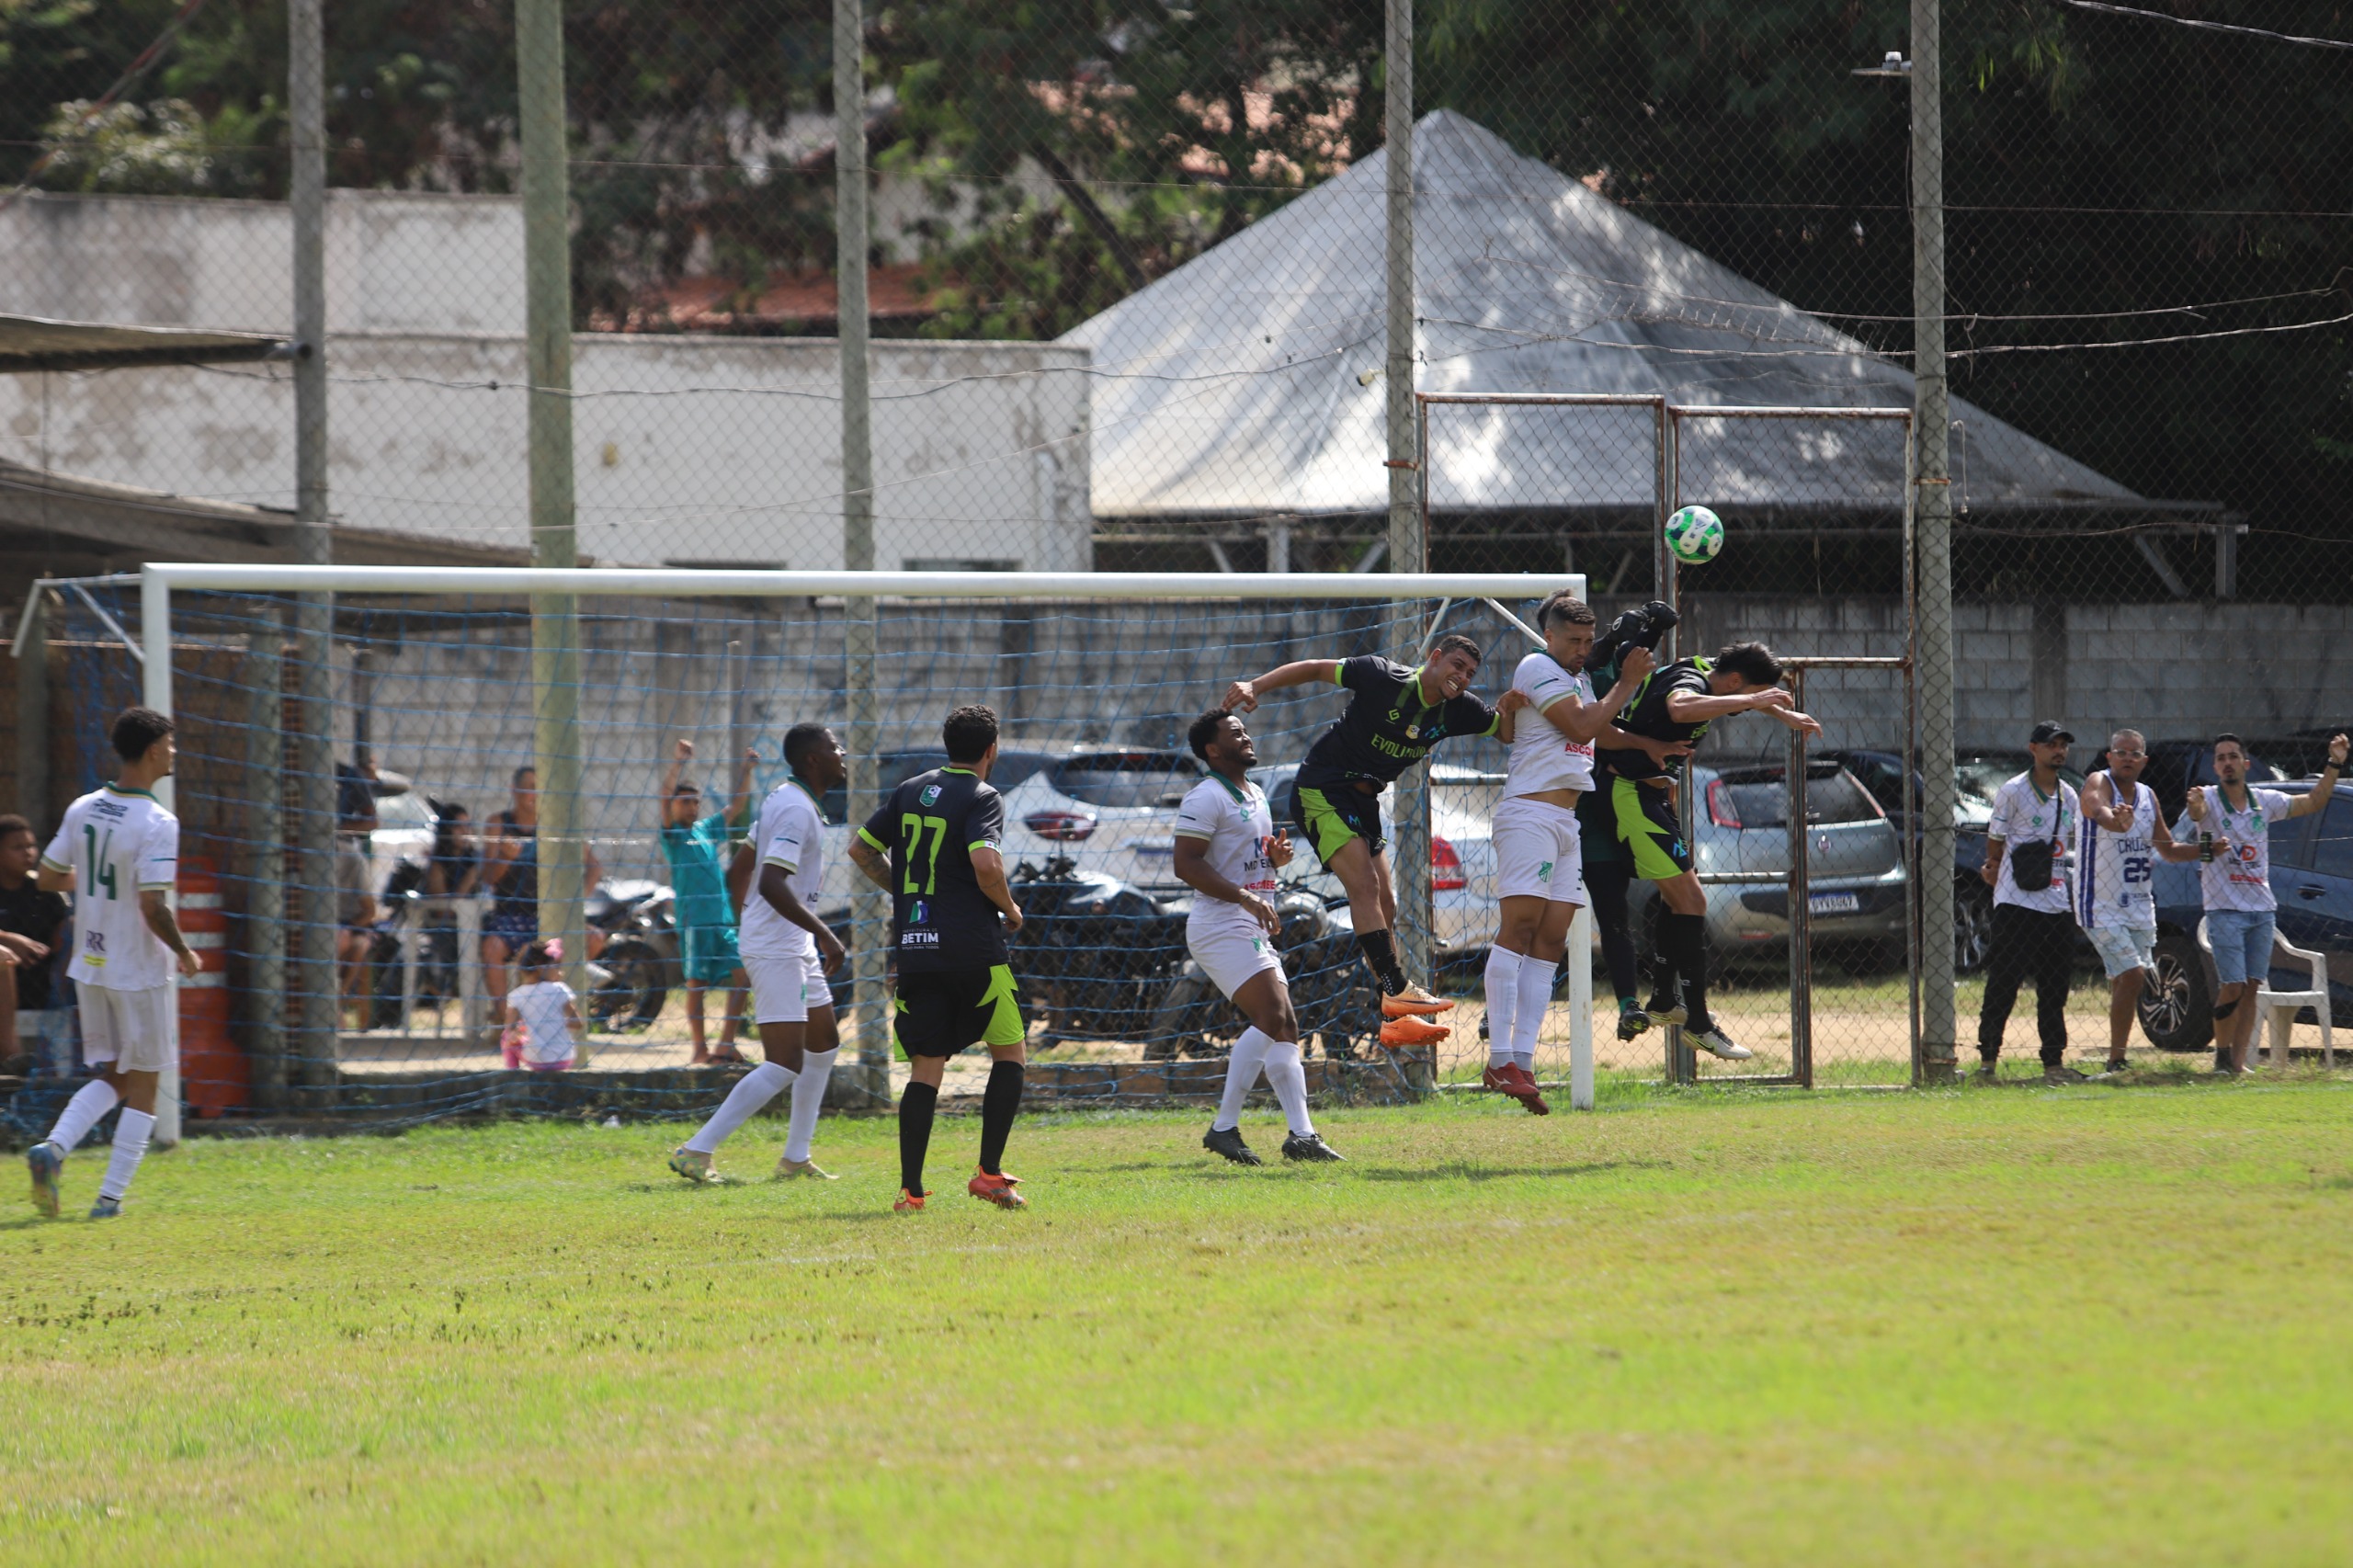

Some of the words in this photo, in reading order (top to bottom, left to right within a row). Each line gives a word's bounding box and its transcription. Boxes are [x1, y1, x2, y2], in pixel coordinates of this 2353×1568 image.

[84, 824, 117, 901] 14
[902, 812, 948, 896] 27
[86, 929, 106, 952] RR
[901, 932, 939, 945] BETIM
